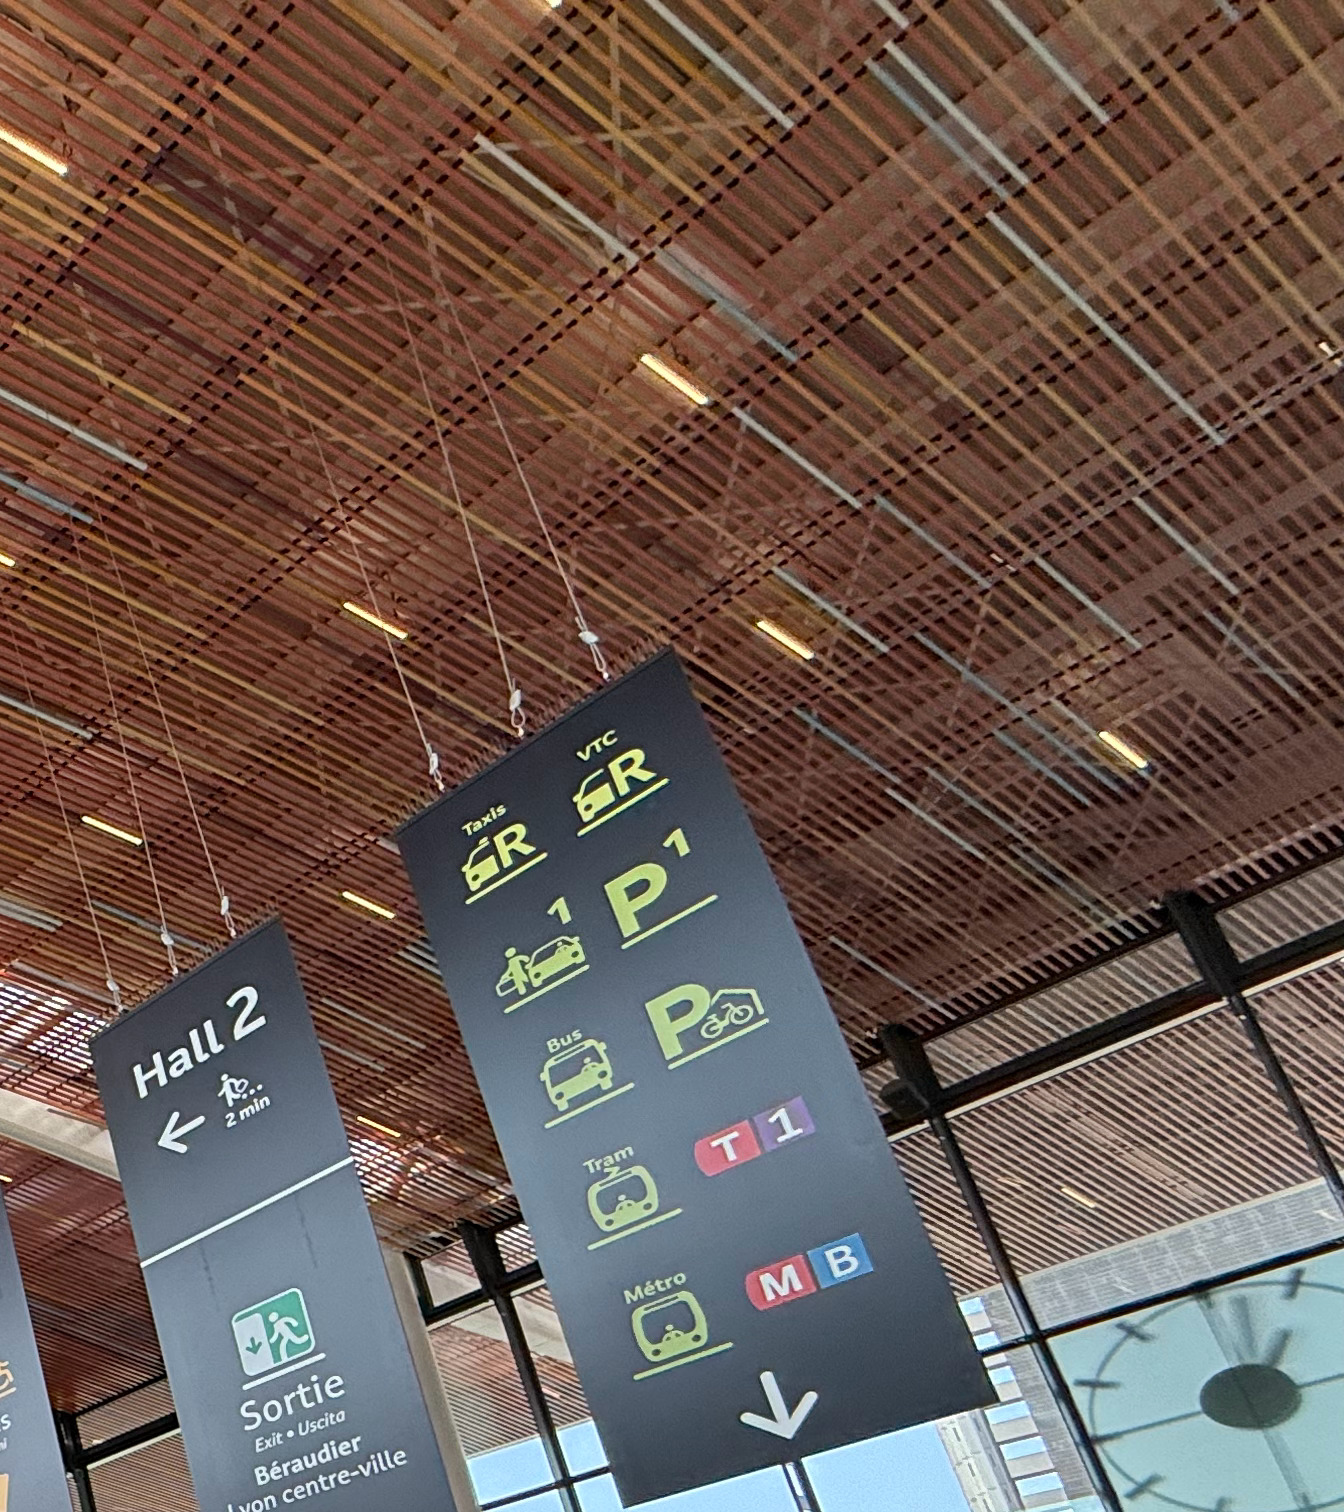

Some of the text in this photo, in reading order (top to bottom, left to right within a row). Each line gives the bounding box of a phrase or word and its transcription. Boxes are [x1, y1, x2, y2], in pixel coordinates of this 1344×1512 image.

[576, 729, 618, 761] VTC
[462, 804, 507, 836] Taxis
[663, 828, 691, 857] 1
[547, 896, 572, 925] 1
[133, 986, 267, 1099] Hall 2
[546, 1028, 583, 1053] Bus
[225, 1096, 271, 1128] 2 min
[710, 1107, 803, 1162] T 1
[583, 1146, 634, 1174] Tram
[623, 1272, 687, 1304] Métro
[759, 1244, 859, 1301] M B
[240, 1375, 346, 1431] Sortie
[255, 1410, 346, 1454] Exit Uscita
[254, 1435, 362, 1486] Béraudier
[282, 1449, 408, 1504] centre-ville
